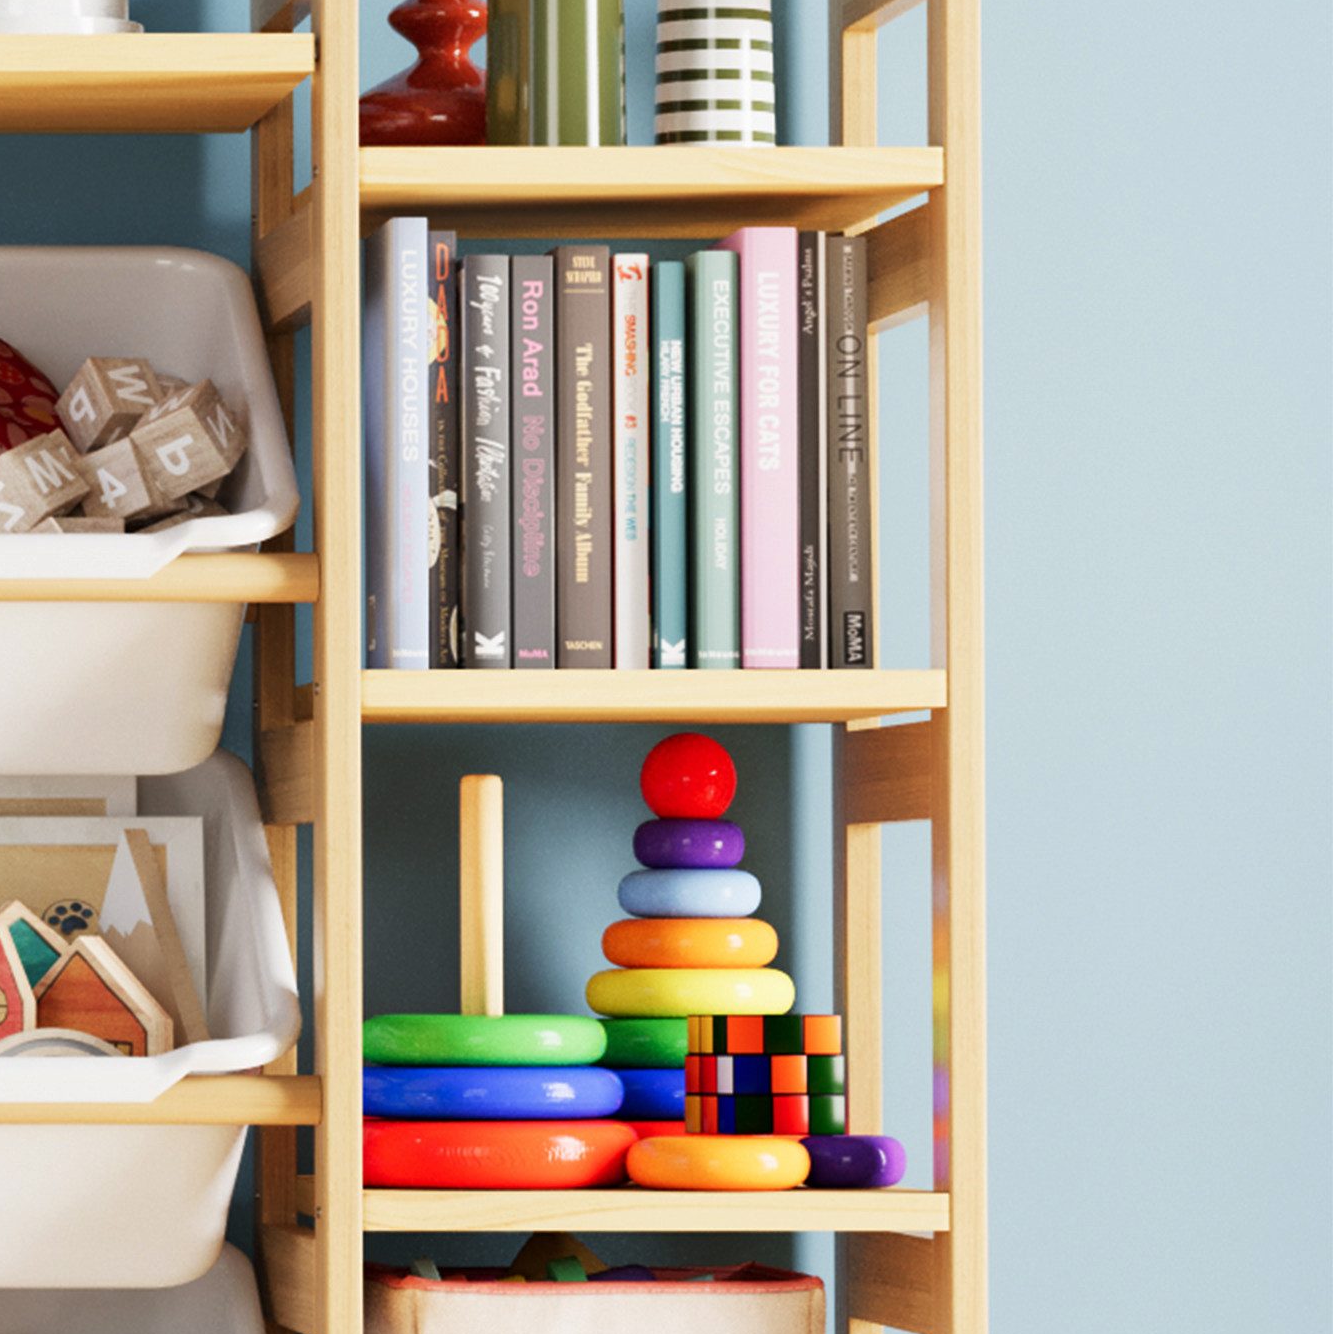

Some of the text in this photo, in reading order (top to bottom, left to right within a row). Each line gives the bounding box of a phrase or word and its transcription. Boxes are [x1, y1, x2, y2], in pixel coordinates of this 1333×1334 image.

[401, 249, 418, 349] LUXURY
[436, 242, 450, 404] DADA
[624, 314, 637, 377] SMASHING
[474, 366, 502, 426] Fashion
[757, 271, 781, 471] LUXURY FOR CATS
[836, 334, 862, 379] ON
[401, 358, 419, 462] HOUSES
[518, 280, 545, 578] Ron Arad No Discipline
[670, 340, 683, 494] NEW URBAN HOUSING
[712, 279, 731, 570] EXECUTIVE ESCAPES HOLIDAY
[837, 394, 864, 463] LINE
[573, 343, 593, 583] The Godfather Family Album
[847, 614, 863, 662] MoMA
